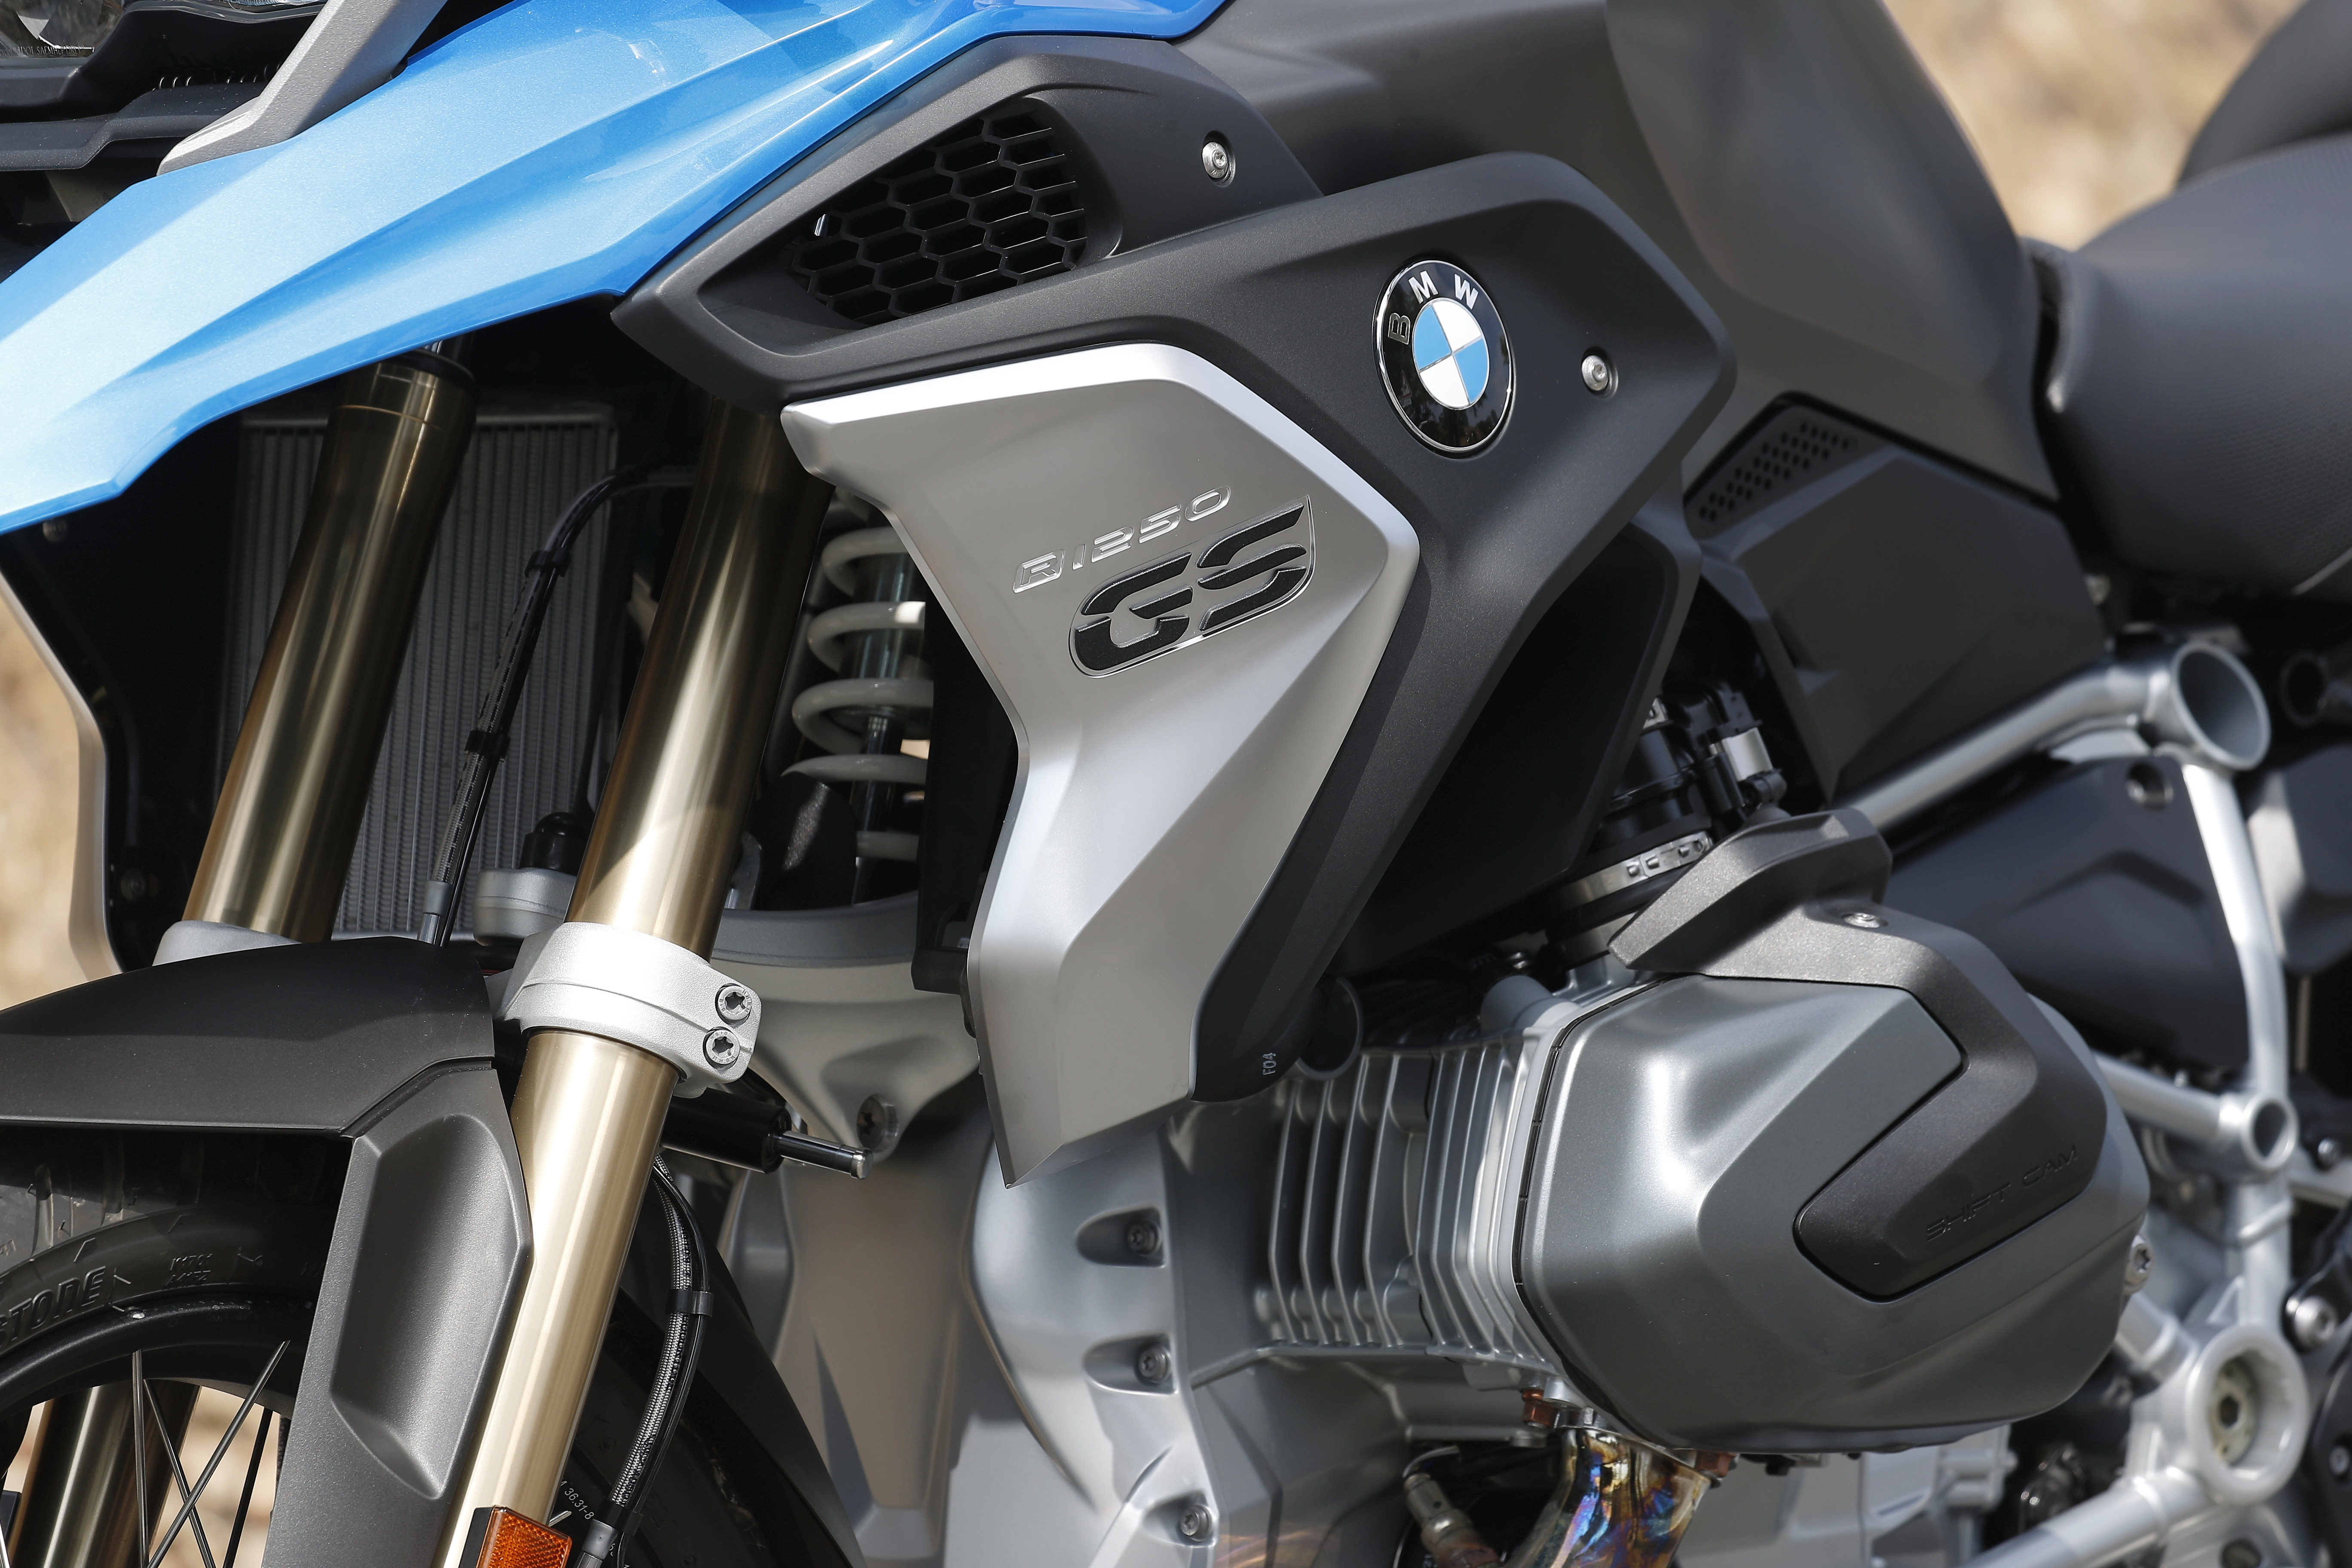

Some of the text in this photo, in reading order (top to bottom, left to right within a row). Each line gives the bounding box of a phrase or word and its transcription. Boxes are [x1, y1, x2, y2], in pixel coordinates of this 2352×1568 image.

[1387, 270, 1479, 345] BMW
[1074, 502, 1307, 671] GS
[1926, 1145, 2078, 1242] SHIFT CAM
